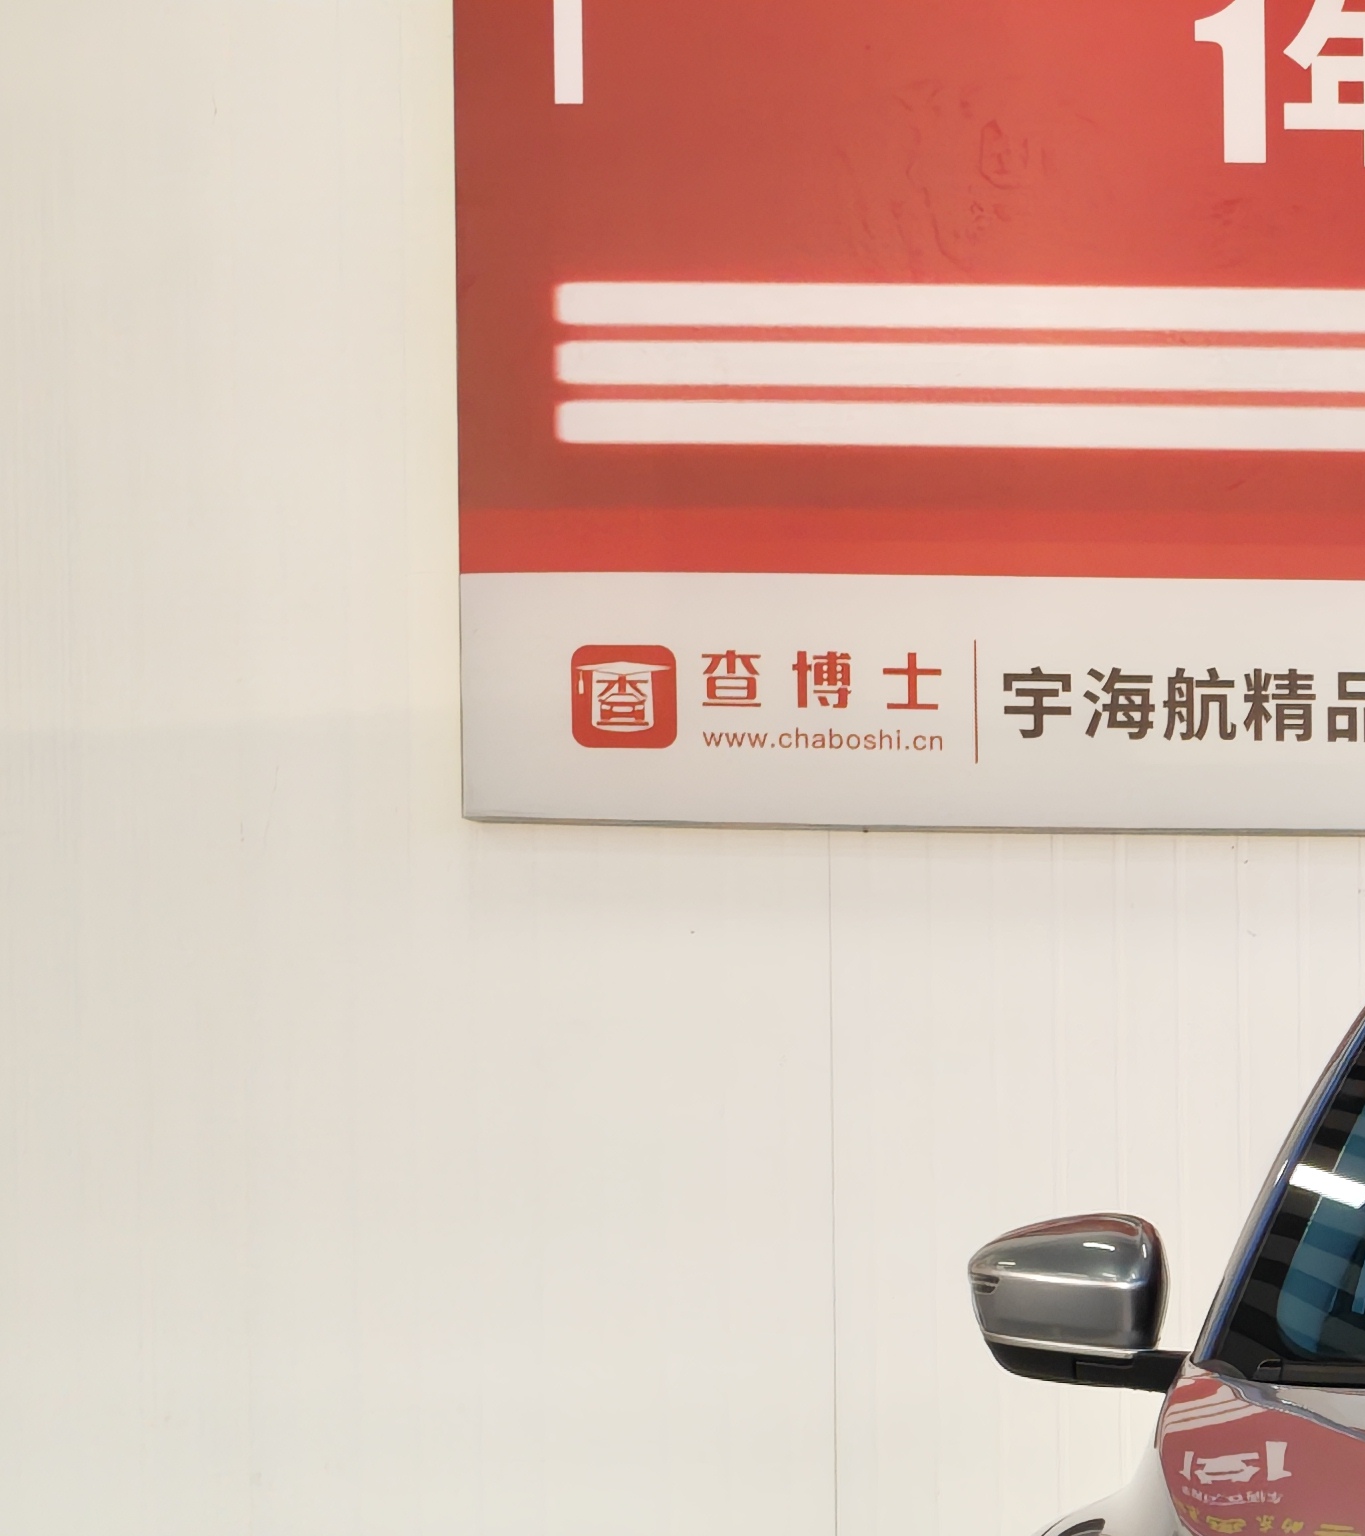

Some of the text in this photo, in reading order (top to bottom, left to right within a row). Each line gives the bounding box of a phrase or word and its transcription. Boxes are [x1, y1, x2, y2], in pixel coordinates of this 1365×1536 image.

[701, 649, 942, 709] 查博士
[702, 728, 943, 751] www.chaboshi.cn
